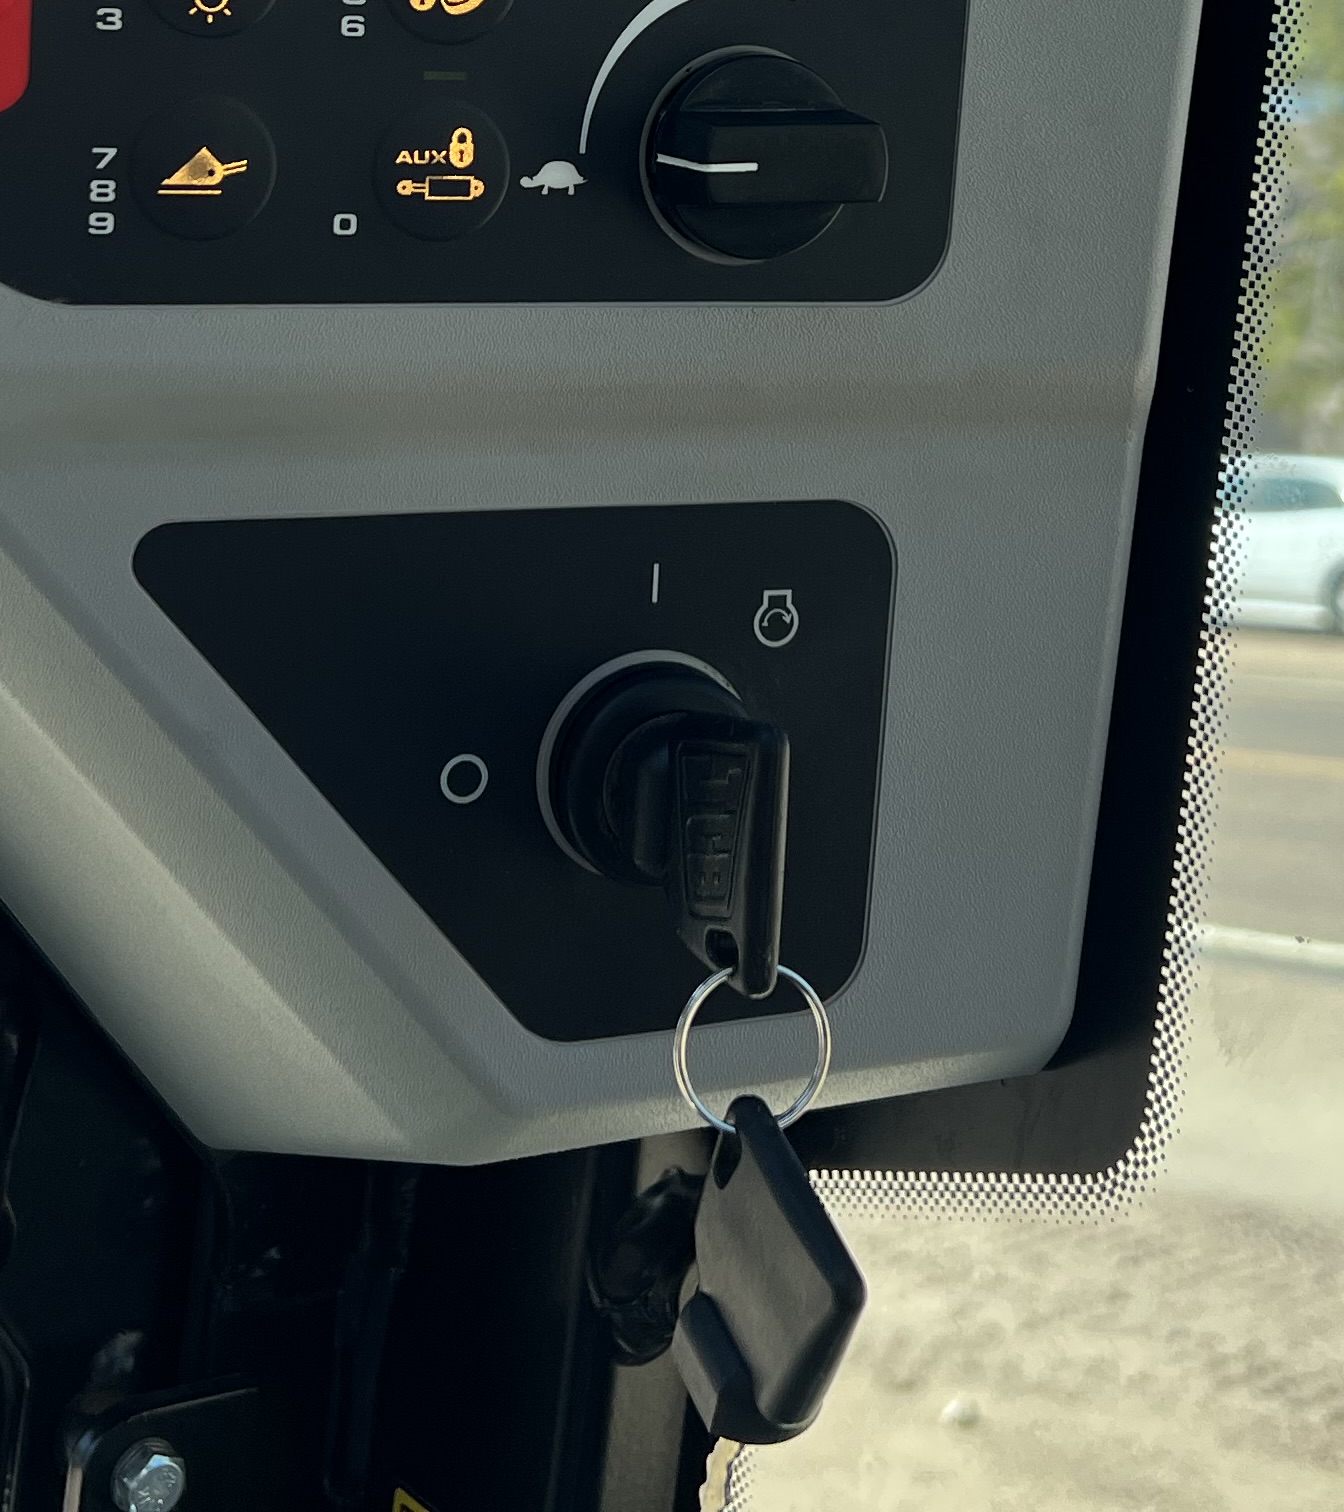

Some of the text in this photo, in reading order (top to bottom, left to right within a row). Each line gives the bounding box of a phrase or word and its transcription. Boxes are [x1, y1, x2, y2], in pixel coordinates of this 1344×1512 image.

[95, 7, 123, 31] 3
[340, 14, 366, 37] 6
[91, 147, 118, 170] 7
[395, 149, 448, 165] AUX
[89, 179, 117, 203] 8
[87, 211, 115, 235] 9
[332, 213, 358, 236] 0
